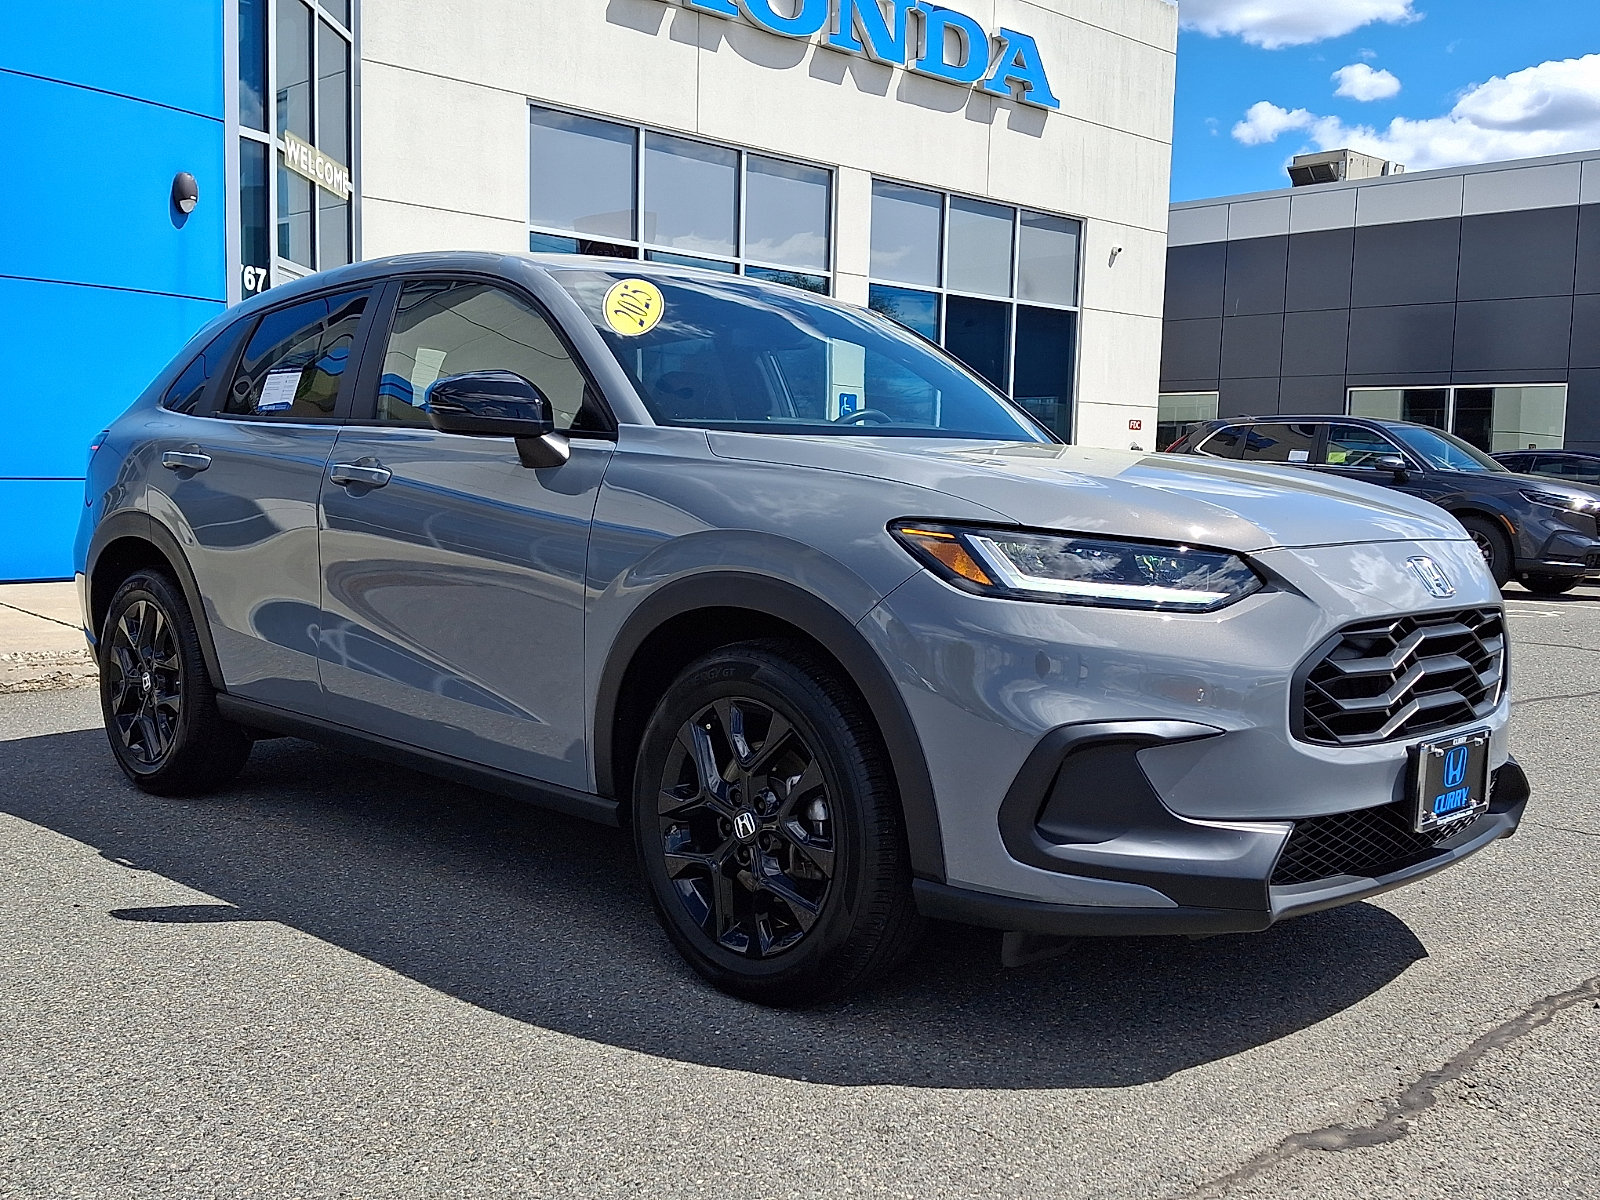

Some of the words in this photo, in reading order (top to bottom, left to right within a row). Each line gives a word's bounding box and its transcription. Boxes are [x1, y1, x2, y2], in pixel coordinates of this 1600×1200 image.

[688, 0, 1060, 109] NDA
[285, 136, 348, 195] WELCOME
[241, 264, 267, 293] 67
[613, 284, 652, 328] 2025
[1434, 787, 1470, 814] CURRY
